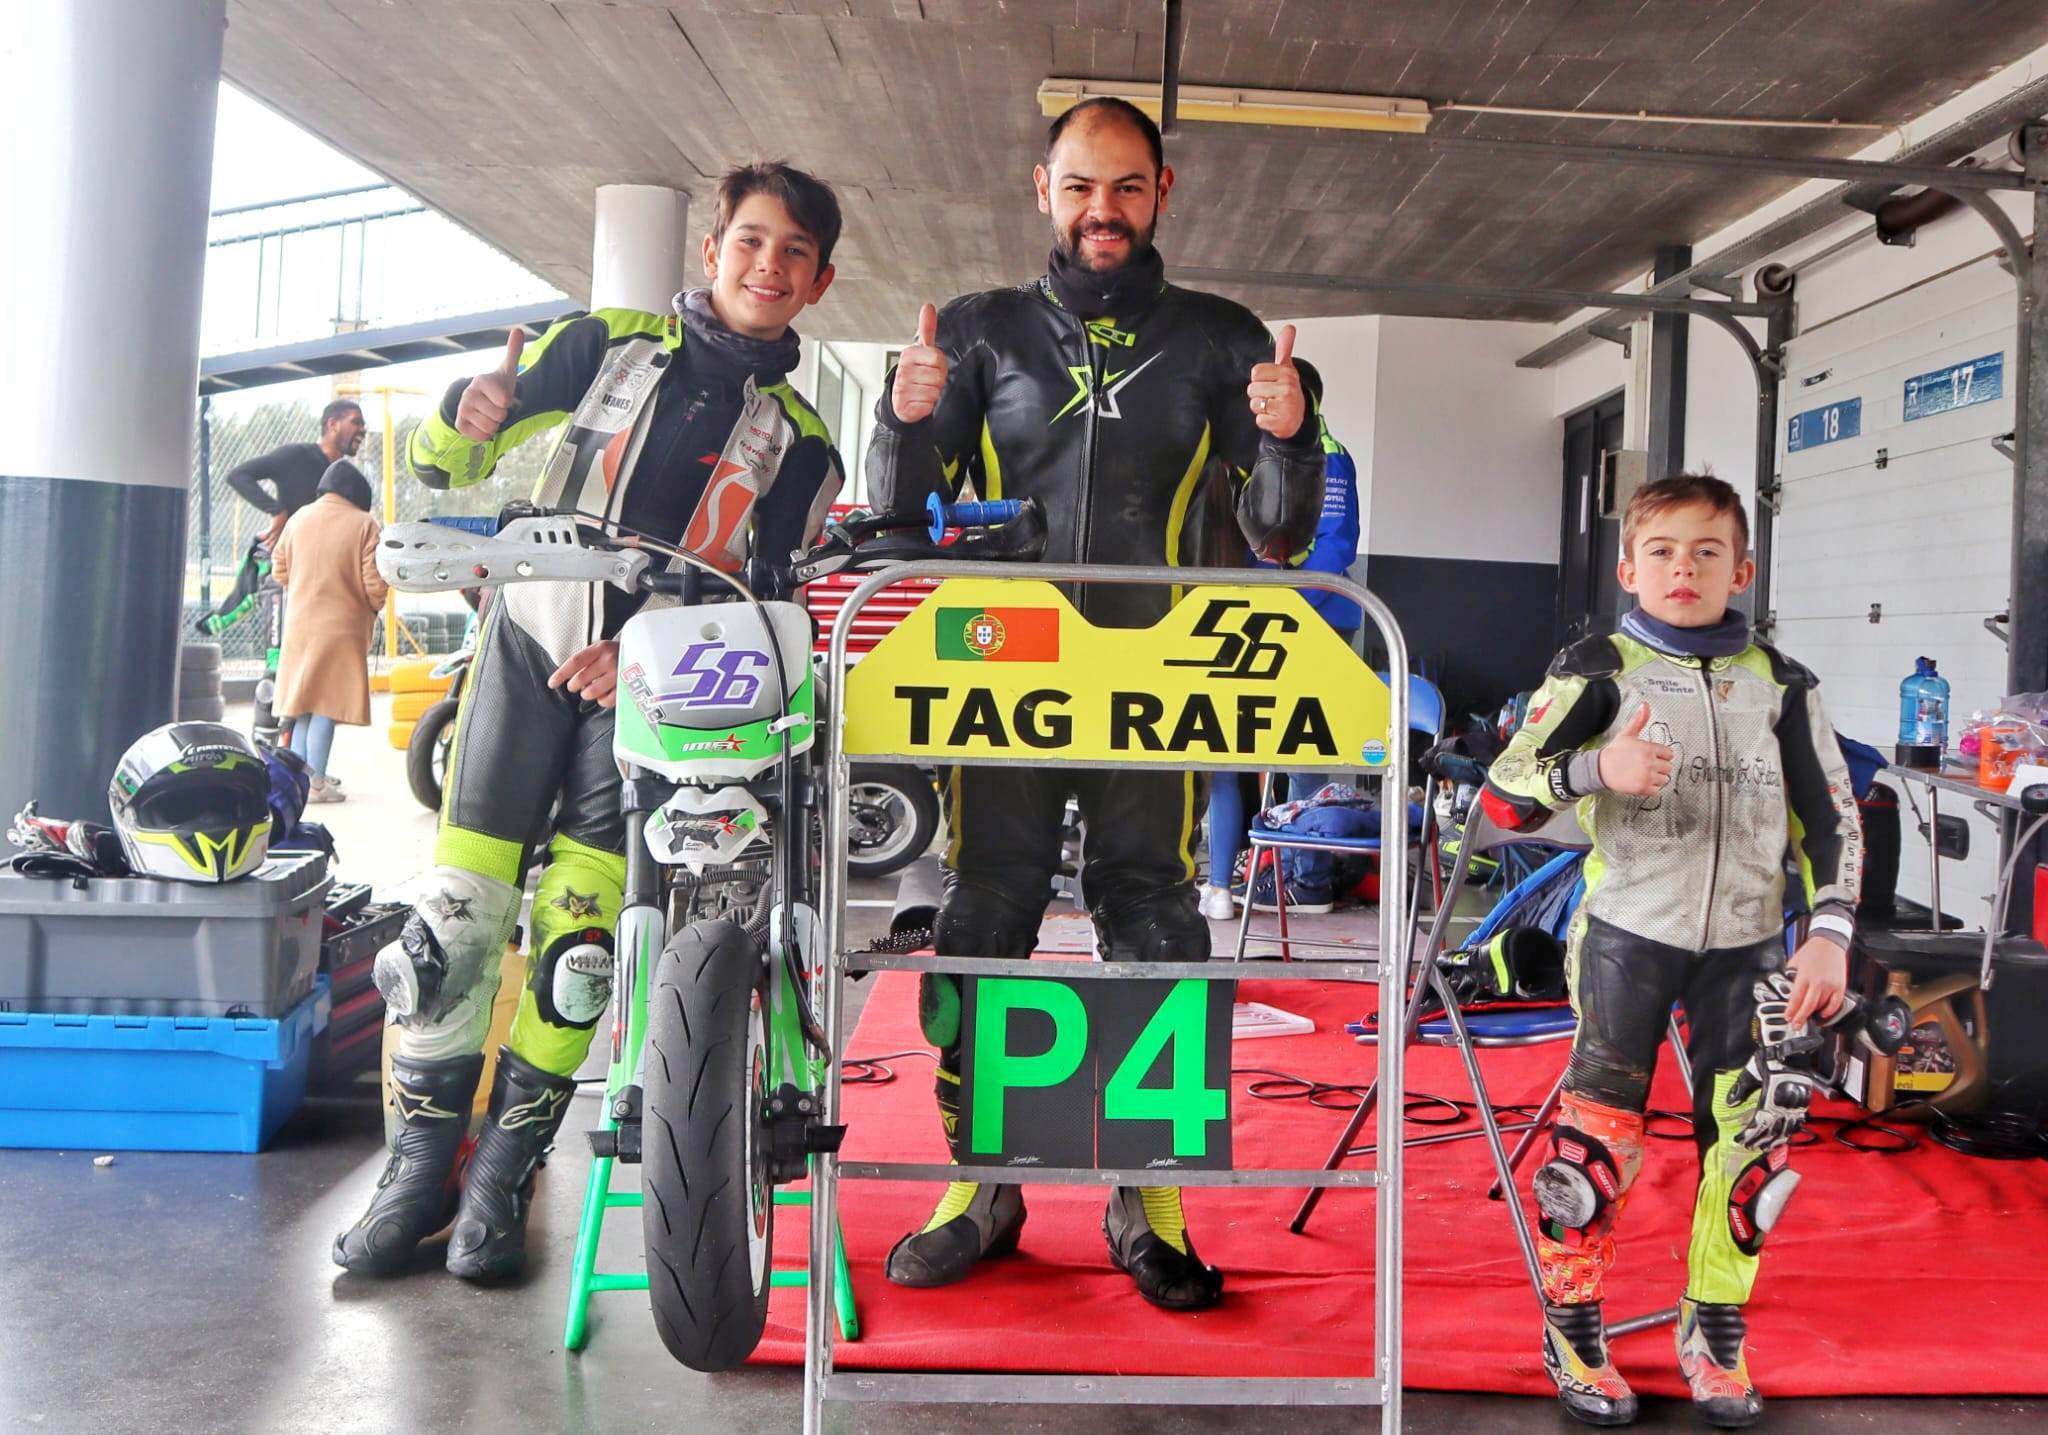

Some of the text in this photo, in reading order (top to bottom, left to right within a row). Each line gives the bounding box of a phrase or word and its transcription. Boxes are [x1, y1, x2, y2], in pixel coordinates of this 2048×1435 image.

[1951, 365, 1974, 405] 17
[1822, 407, 1840, 440] 18
[1163, 599, 1299, 680] 56
[655, 642, 769, 711] 56
[894, 686, 1339, 756] TAG RAFA
